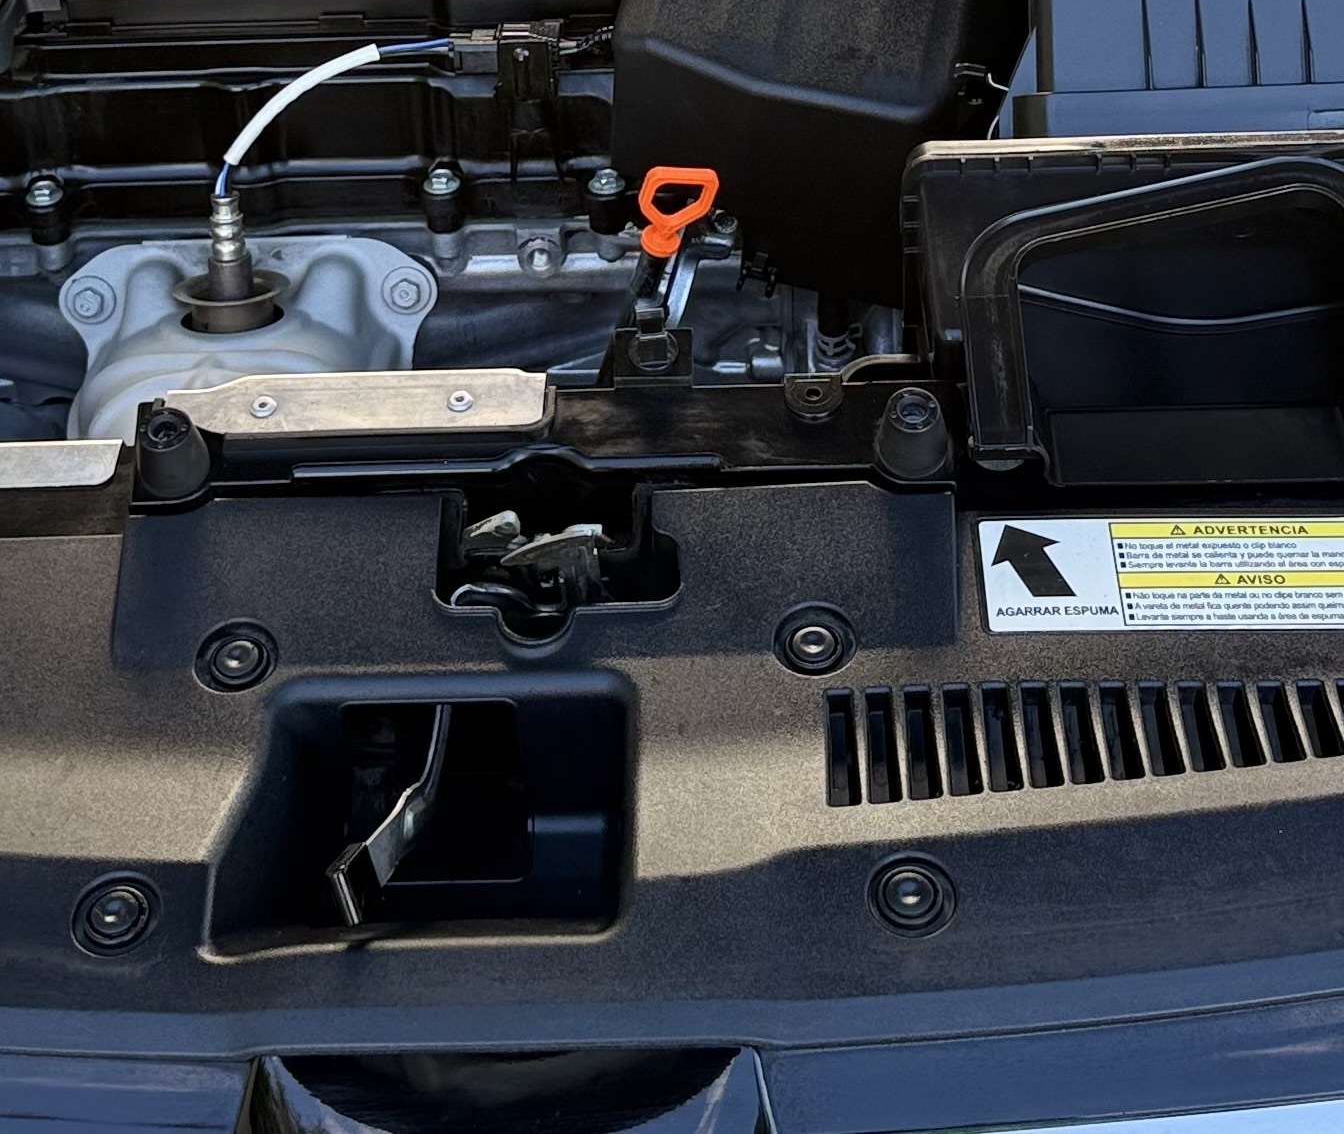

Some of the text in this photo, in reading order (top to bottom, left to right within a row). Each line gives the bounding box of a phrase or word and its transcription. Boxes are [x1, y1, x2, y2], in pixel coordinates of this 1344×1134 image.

[1193, 526, 1309, 535] ADVERTENCIA
[1248, 551, 1274, 559] puede
[1128, 561, 1164, 569] Siempre
[1237, 575, 1286, 584] AVISO
[1152, 592, 1175, 600] toque
[1254, 602, 1290, 610] podendo
[996, 606, 1119, 617] AGARRAR ESPUMA
